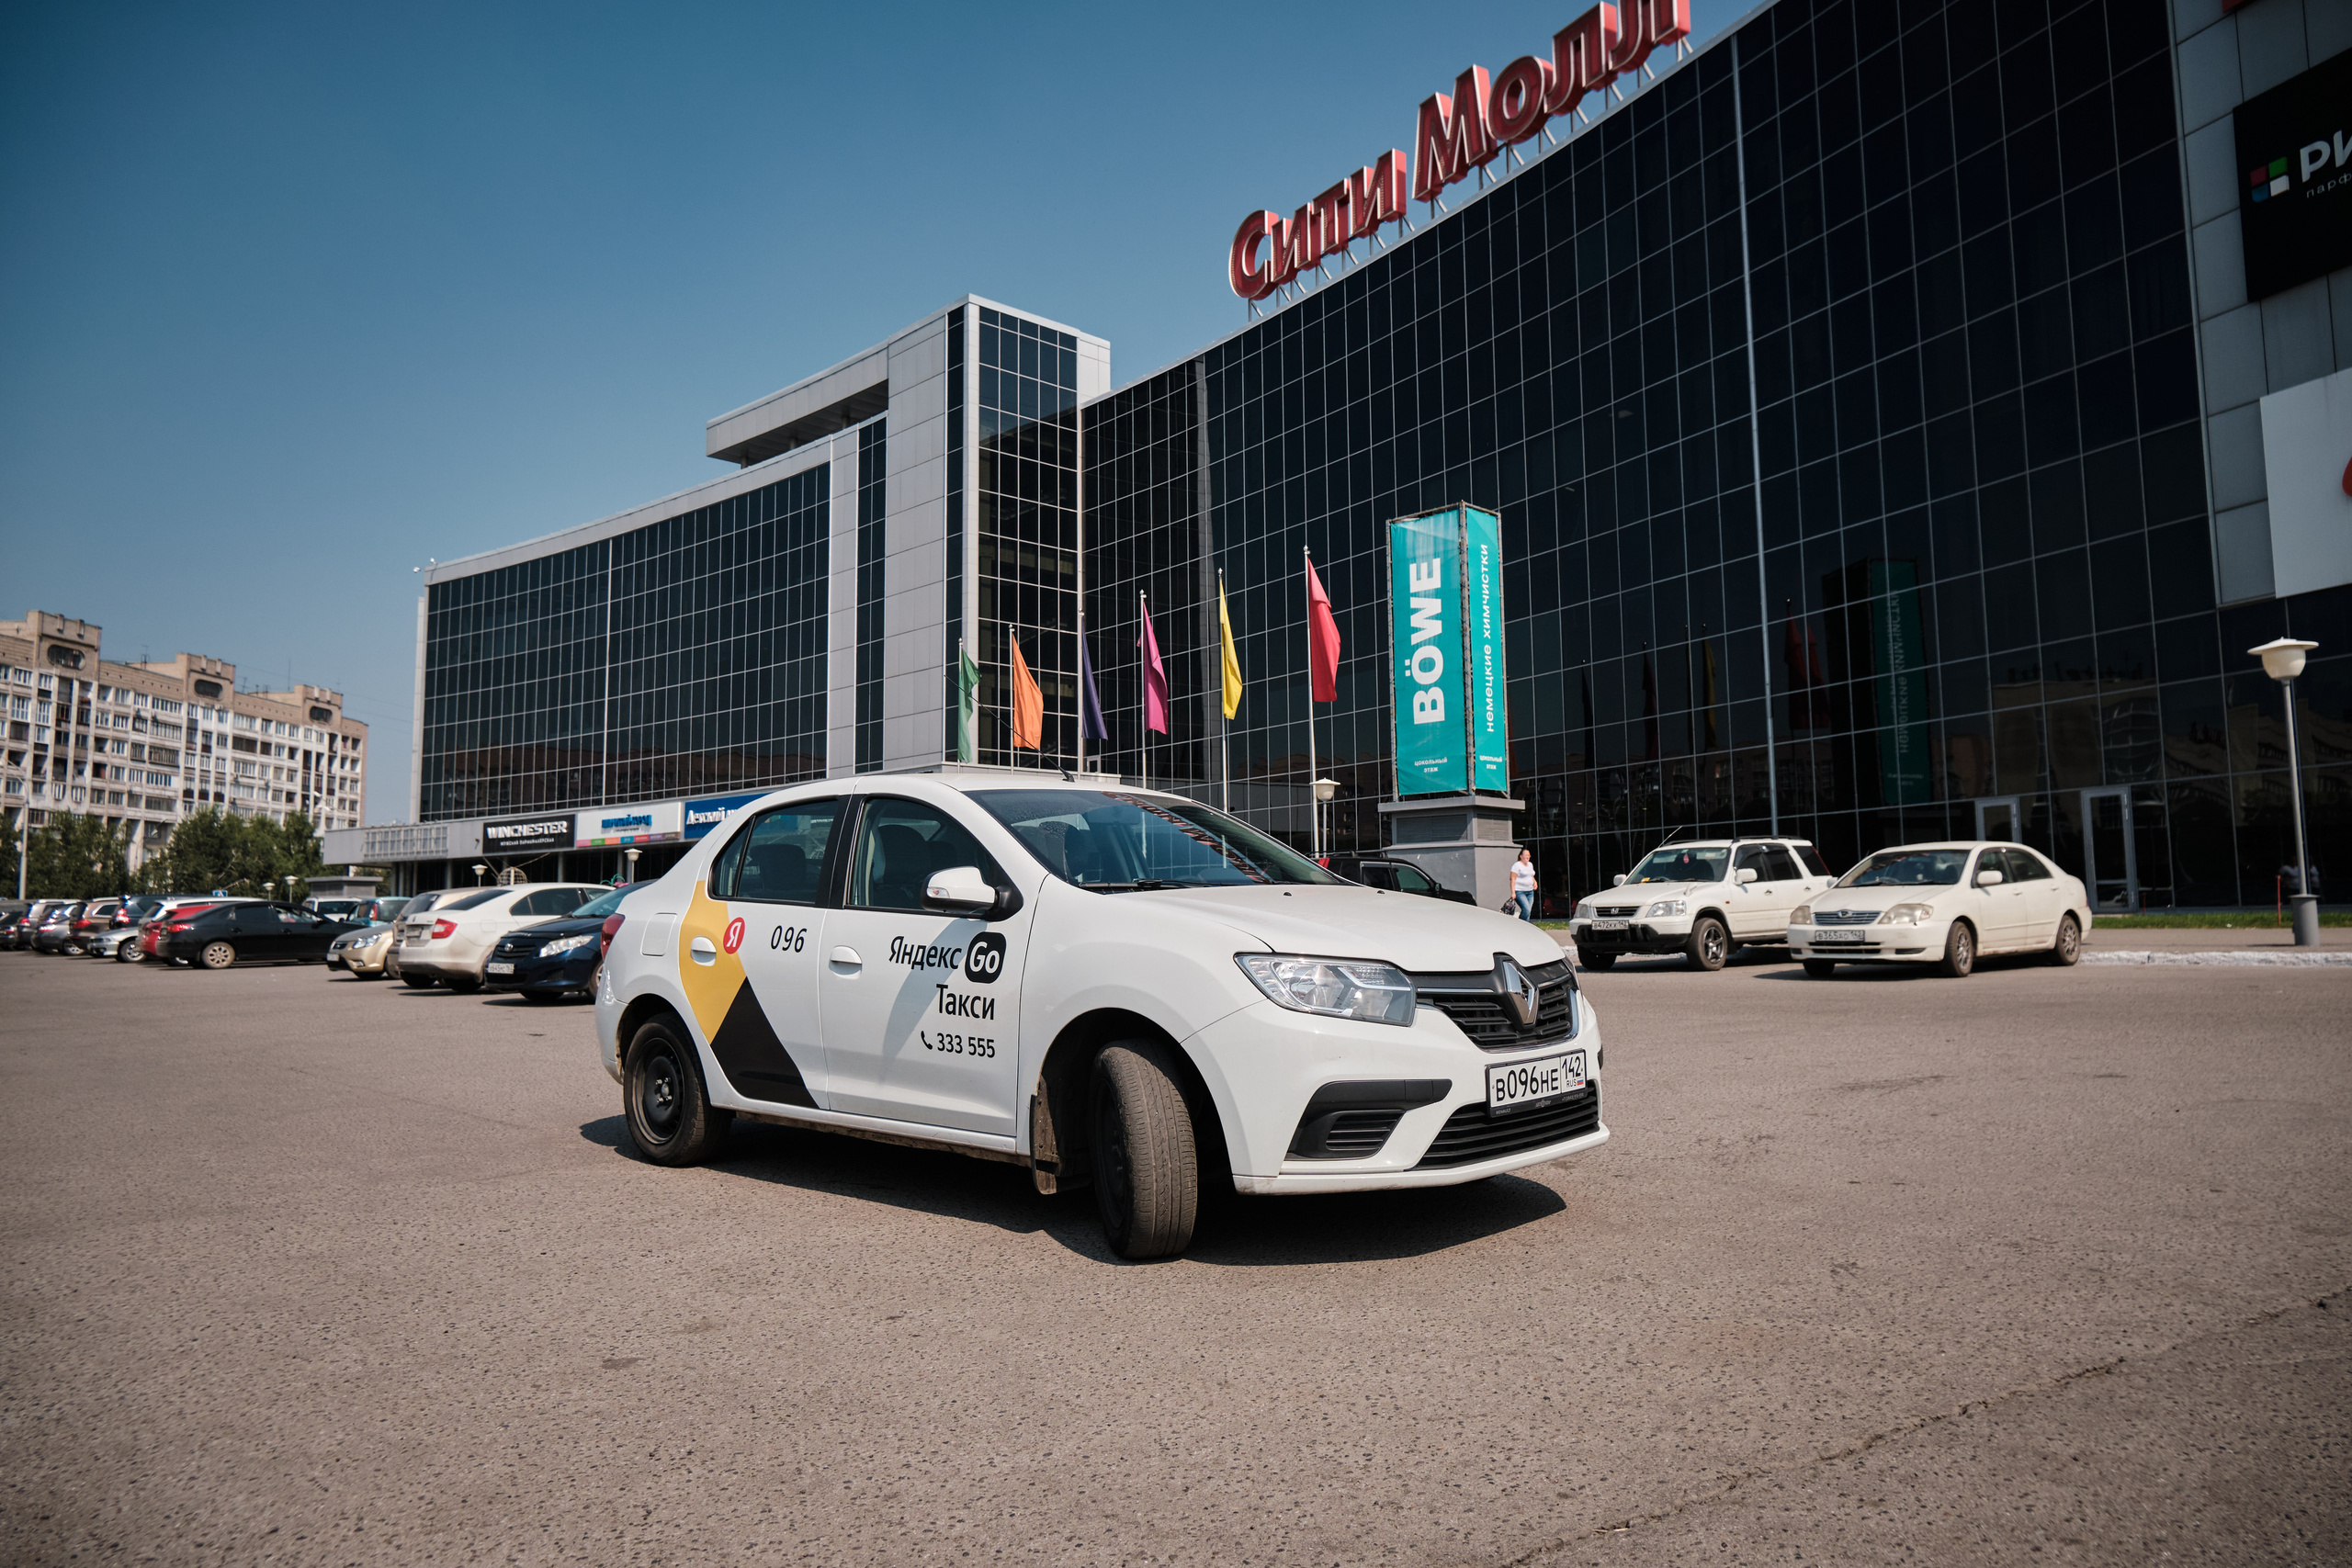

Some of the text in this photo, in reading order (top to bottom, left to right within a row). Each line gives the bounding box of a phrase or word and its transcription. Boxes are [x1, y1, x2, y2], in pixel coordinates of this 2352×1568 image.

[1405, 558, 1445, 725] BÖWE
[486, 820, 568, 840] WINCHESTER
[770, 925, 808, 953] 096
[888, 935, 1001, 975] Яндекс Go
[935, 984, 995, 1021] Такси
[936, 1032, 996, 1058] 333 555
[1562, 1055, 1581, 1080] 142
[1566, 1079, 1577, 1088] RUS
